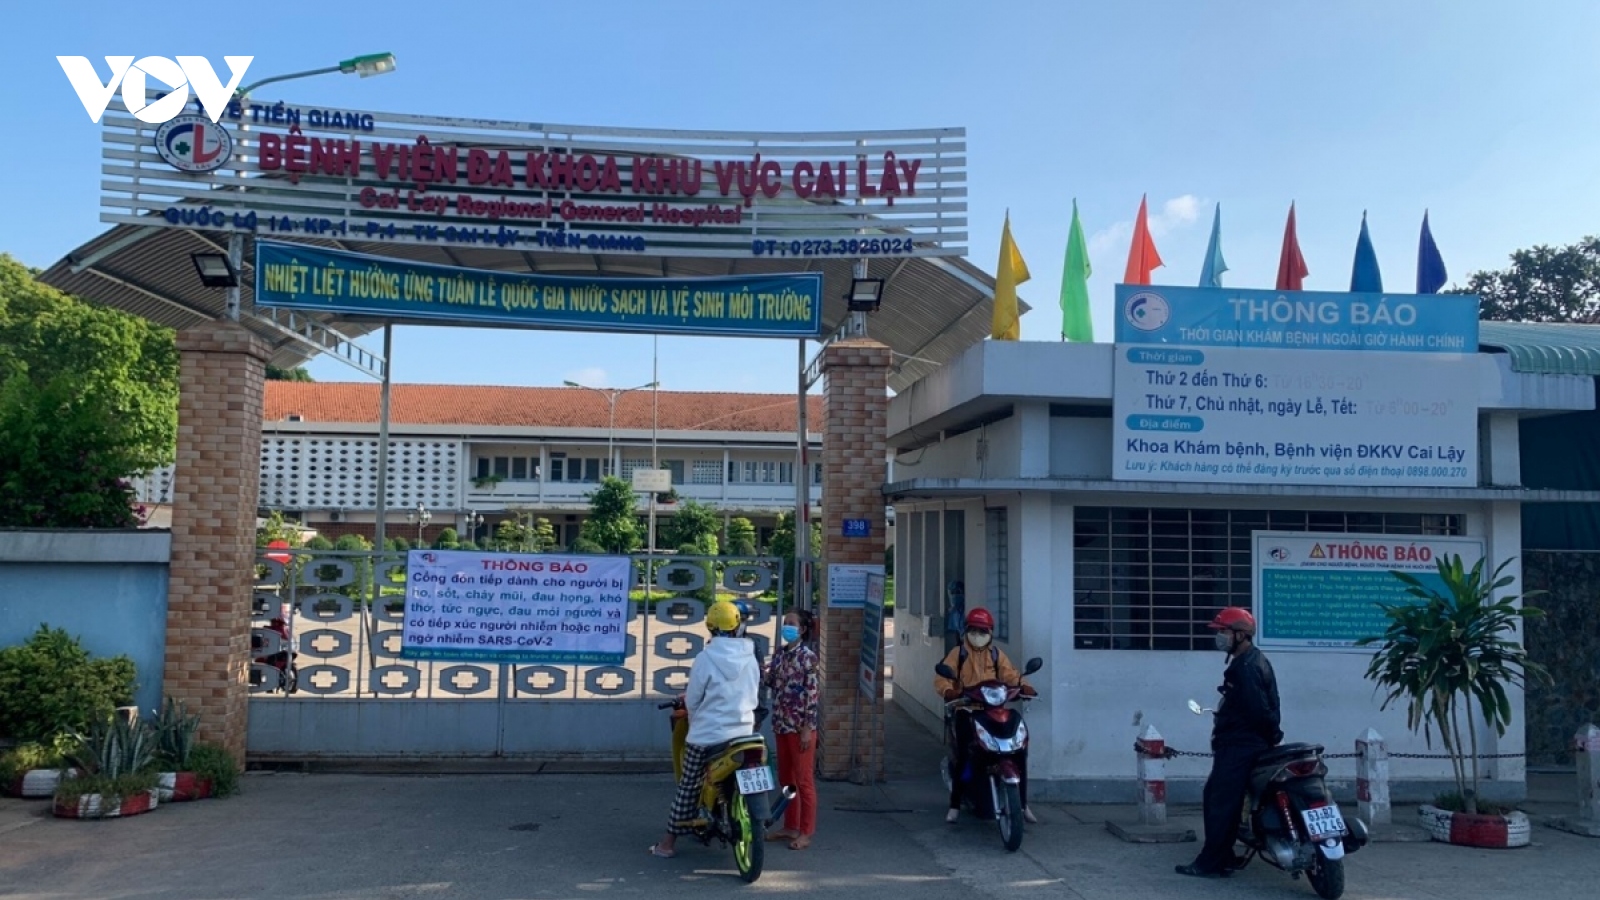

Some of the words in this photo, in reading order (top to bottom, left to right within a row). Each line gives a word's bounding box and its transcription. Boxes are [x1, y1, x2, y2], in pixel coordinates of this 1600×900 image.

[308, 109, 374, 132] GIANG
[259, 125, 361, 184] BỆNH
[372, 134, 458, 192] VIỆN
[467, 148, 514, 187] ĐA
[526, 152, 622, 192] KHOA
[632, 155, 702, 195] KHU
[714, 153, 782, 207] VỰC
[793, 160, 847, 198] CAI
[858, 150, 921, 206] LẬY
[360, 186, 399, 209] Cai
[408, 190, 448, 215] Lay
[457, 194, 553, 220] Regional
[560, 200, 645, 223] General
[652, 203, 742, 226] Hospital
[165, 206, 225, 228] QUỐC
[445, 226, 477, 243] CAI
[587, 233, 645, 251] GIANG
[264, 258, 309, 299] NHIỆT
[312, 261, 345, 302] LIỆT
[350, 262, 400, 300] HƯỞNG
[404, 269, 434, 303] ỨNG
[437, 272, 475, 305] TUẦN
[479, 274, 497, 306] LỄ
[501, 278, 539, 312] QUỐC
[543, 285, 565, 311] GIA
[570, 284, 607, 313] NƯỚC
[611, 288, 646, 320] SẠCH
[651, 285, 669, 316] VÀ
[672, 283, 689, 323] VỆ
[692, 291, 724, 318] SINH
[728, 285, 753, 319] MÔI
[758, 287, 812, 322] TRƯỜNG
[1228, 295, 1340, 324] THÔNG
[1351, 297, 1417, 326] BÁO
[1180, 326, 1210, 341] THỜI
[1213, 328, 1242, 343] GIAN
[1247, 328, 1282, 344] KHÁM
[1286, 330, 1319, 347] BỆNH
[1323, 331, 1361, 346] NGOÀI
[1364, 330, 1389, 346] GIỜ
[1390, 331, 1424, 347] HÀNH
[1427, 332, 1465, 348] CHÍNH
[1139, 350, 1166, 361] Thời
[1168, 351, 1193, 363] gian
[1146, 369, 1176, 386] Thứ
[1179, 371, 1188, 386] 2
[1191, 369, 1218, 387] đến
[1222, 372, 1251, 388] Thứ
[1255, 373, 1268, 388] 6:
[1145, 393, 1176, 410] Thứ
[1179, 396, 1192, 412] 7,
[1196, 396, 1225, 411] Chủ
[1228, 397, 1264, 416] nhật,
[1268, 399, 1302, 417] ngày
[1306, 396, 1328, 416] Lễ,
[1332, 396, 1357, 415] Tết:
[1139, 418, 1158, 431] Địa
[1162, 418, 1191, 430] điểm
[1127, 438, 1169, 453] Khoa
[1174, 439, 1220, 455] Khám
[1226, 442, 1270, 459] bệnh,
[1275, 442, 1315, 460] Bệnh
[1320, 444, 1352, 461] viện
[1356, 444, 1404, 459] ĐKKV
[1408, 445, 1433, 459] Cai
[1438, 445, 1465, 462] Lậy
[1125, 460, 1146, 471] Lưu
[1160, 460, 1192, 472] Khách
[1194, 461, 1218, 475] hàng
[1221, 462, 1234, 474] có
[1236, 461, 1251, 474] thể
[1294, 464, 1321, 475] trước
[1324, 466, 1341, 478] qua
[1343, 462, 1356, 476] số
[1358, 465, 1379, 478] điện
[1381, 465, 1405, 478] thoại
[1407, 466, 1467, 478] 0898.000.270
[1326, 541, 1388, 560] THÔNG
[1394, 542, 1432, 562] BÁO
[481, 558, 544, 572] THÔNG
[549, 560, 588, 573] BÁO
[412, 571, 446, 585] Cổng
[451, 573, 475, 584] đón
[480, 573, 502, 586] tiếp
[507, 576, 538, 586] dành
[543, 577, 566, 587] cho
[570, 578, 607, 589] người
[612, 578, 623, 590] bị
[465, 590, 495, 602] chảy
[500, 590, 526, 602] mũi,
[532, 592, 555, 602] đau
[600, 593, 622, 603] khó
[441, 603, 462, 613] tức
[508, 605, 531, 616] đau
[537, 606, 560, 616] mỏi
[565, 608, 602, 618] người
[607, 609, 621, 618] và
[409, 618, 425, 627] có
[428, 617, 451, 630] tiếp
[455, 619, 476, 629] xúc
[480, 621, 517, 632] người
[521, 620, 557, 631] nhiễm
[561, 621, 590, 634] hoặc
[594, 622, 620, 635] nghi
[408, 634, 434, 644] ngờ
[437, 633, 474, 644] nhiễm
[478, 634, 553, 646] SARS-CoV-2
